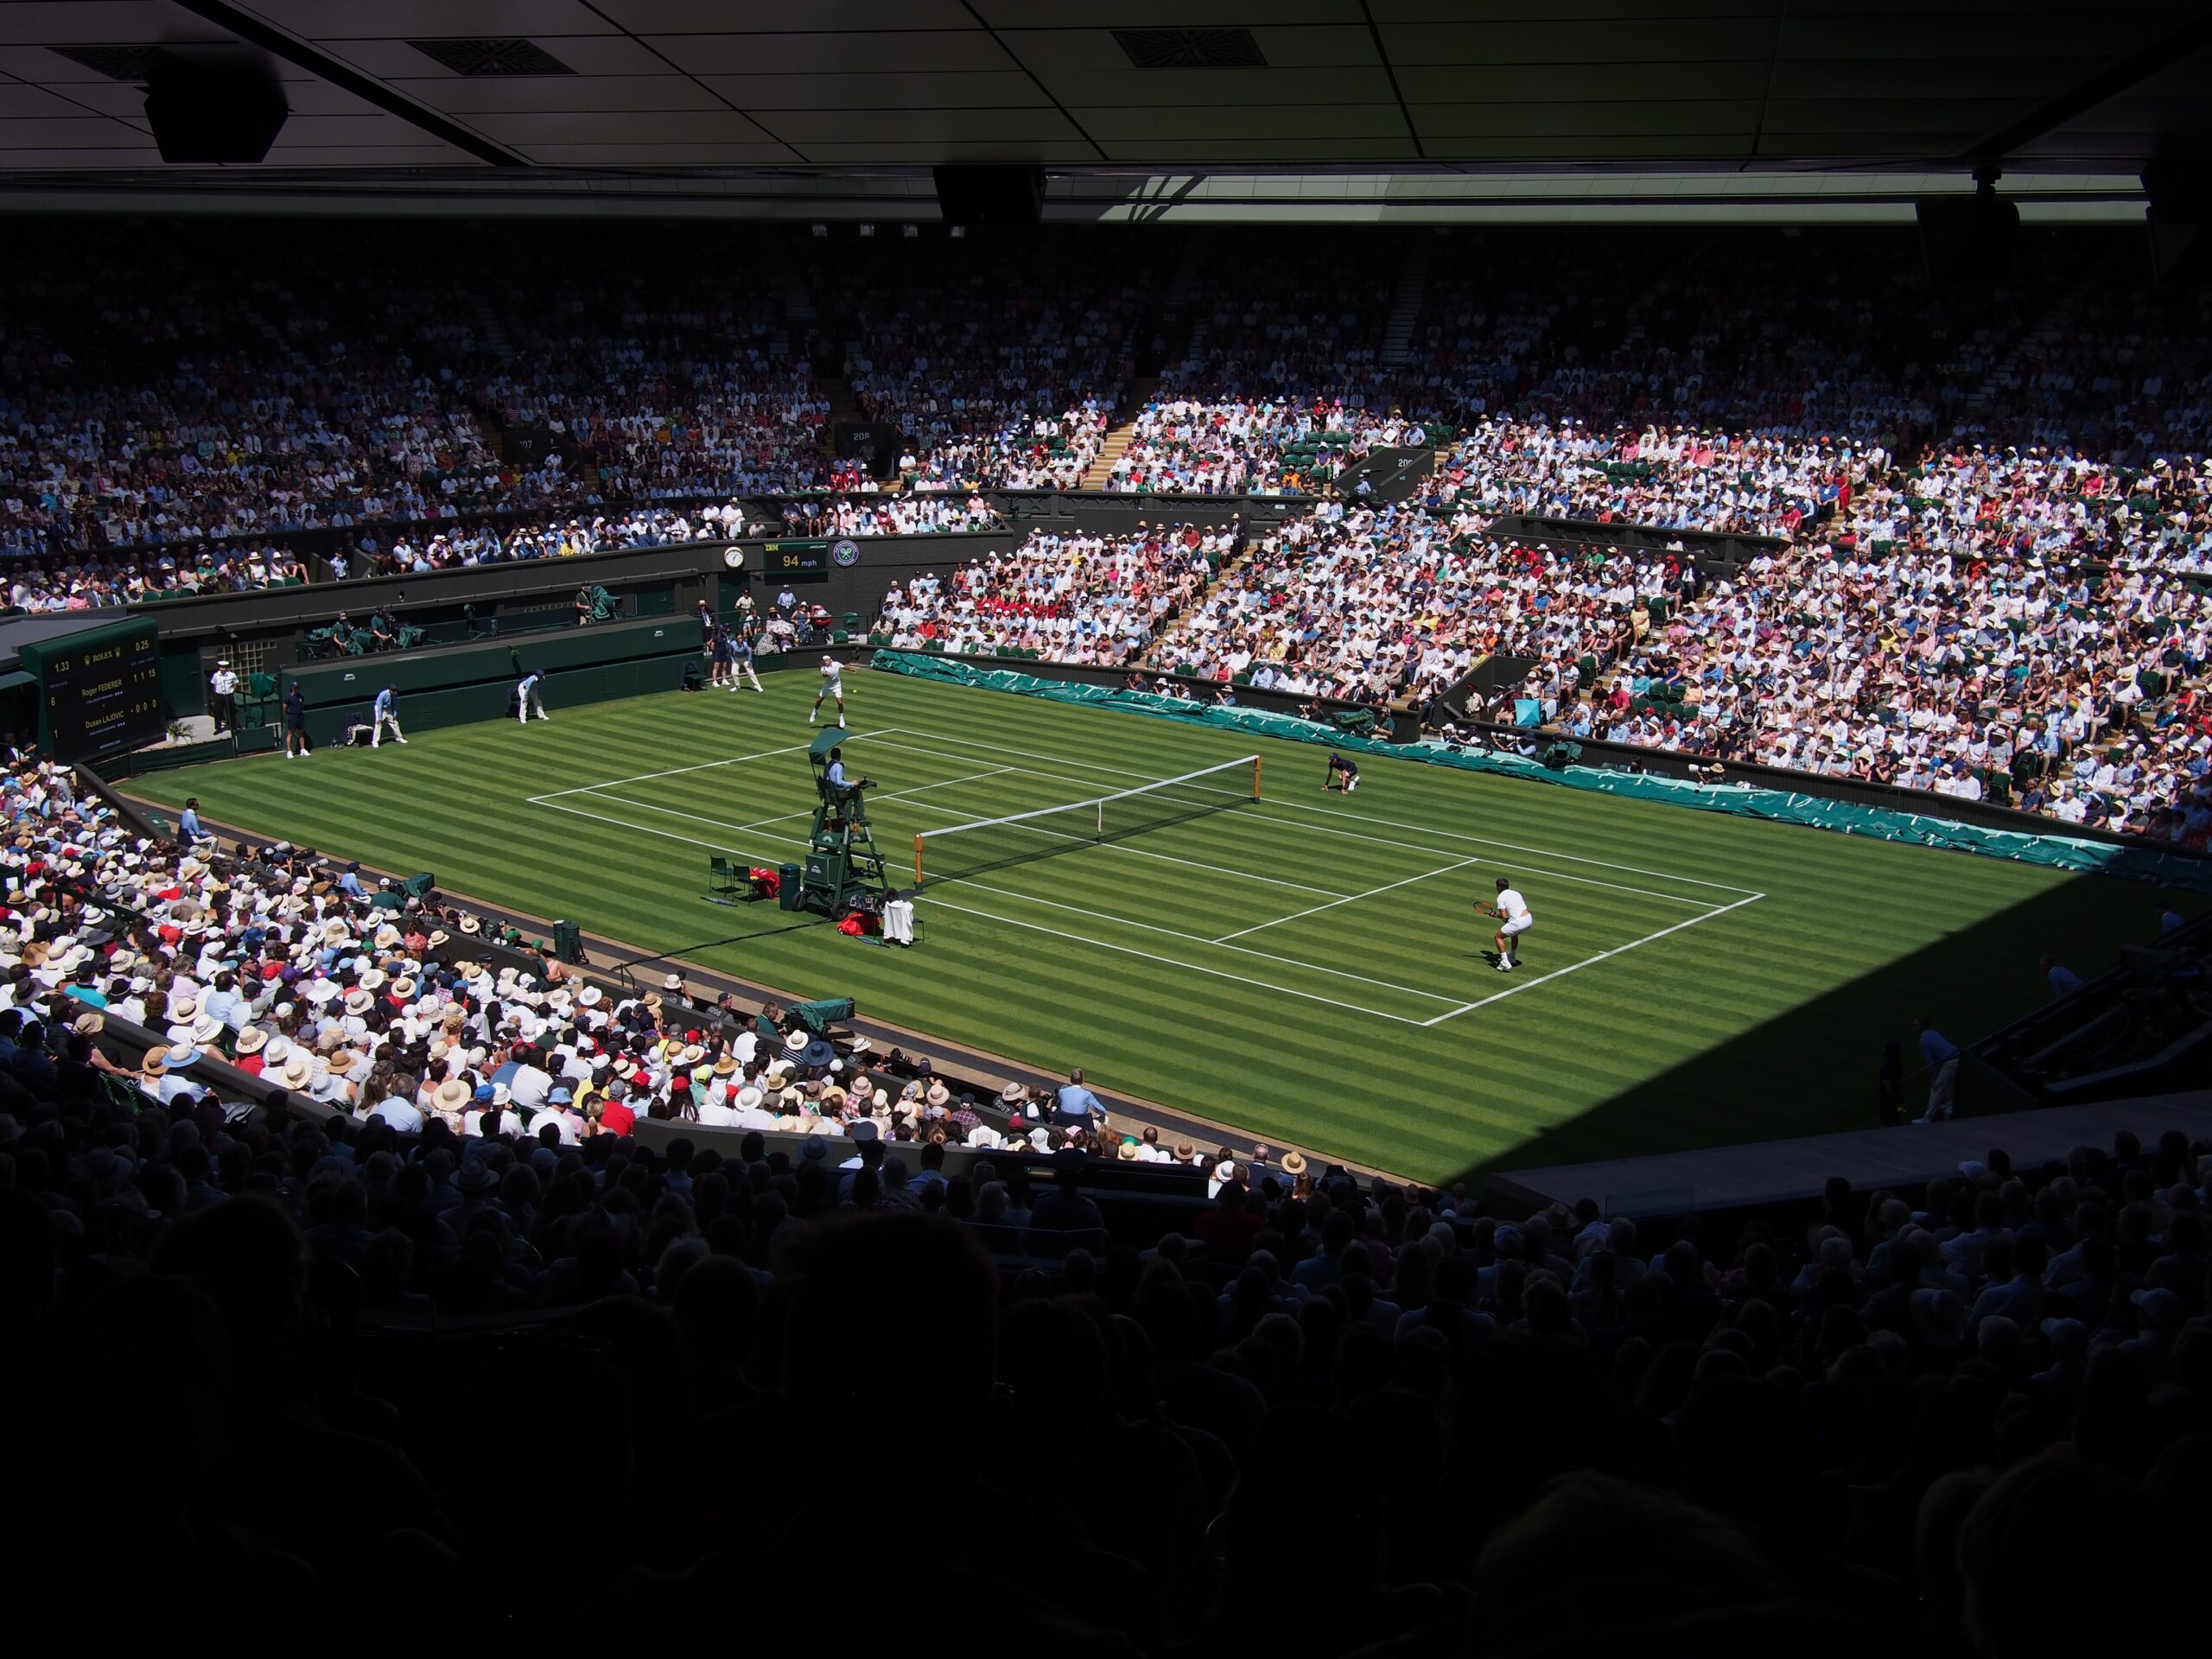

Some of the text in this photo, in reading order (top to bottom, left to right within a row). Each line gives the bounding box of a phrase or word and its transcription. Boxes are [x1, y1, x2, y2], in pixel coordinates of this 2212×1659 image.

[783, 555, 817, 568] 94 mph
[135, 639, 149, 652] 0.25
[92, 651, 112, 663] ROLEX
[55, 661, 69, 673] 1.33
[149, 668, 156, 677] 15
[82, 687, 98, 698] Roger
[98, 679, 123, 693] FEDERER
[50, 696, 55, 706] 6
[136, 699, 156, 713] 0 0 0
[86, 711, 124, 728] Dusan LAJOVIC
[995, 1098, 1010, 1114] 0207
